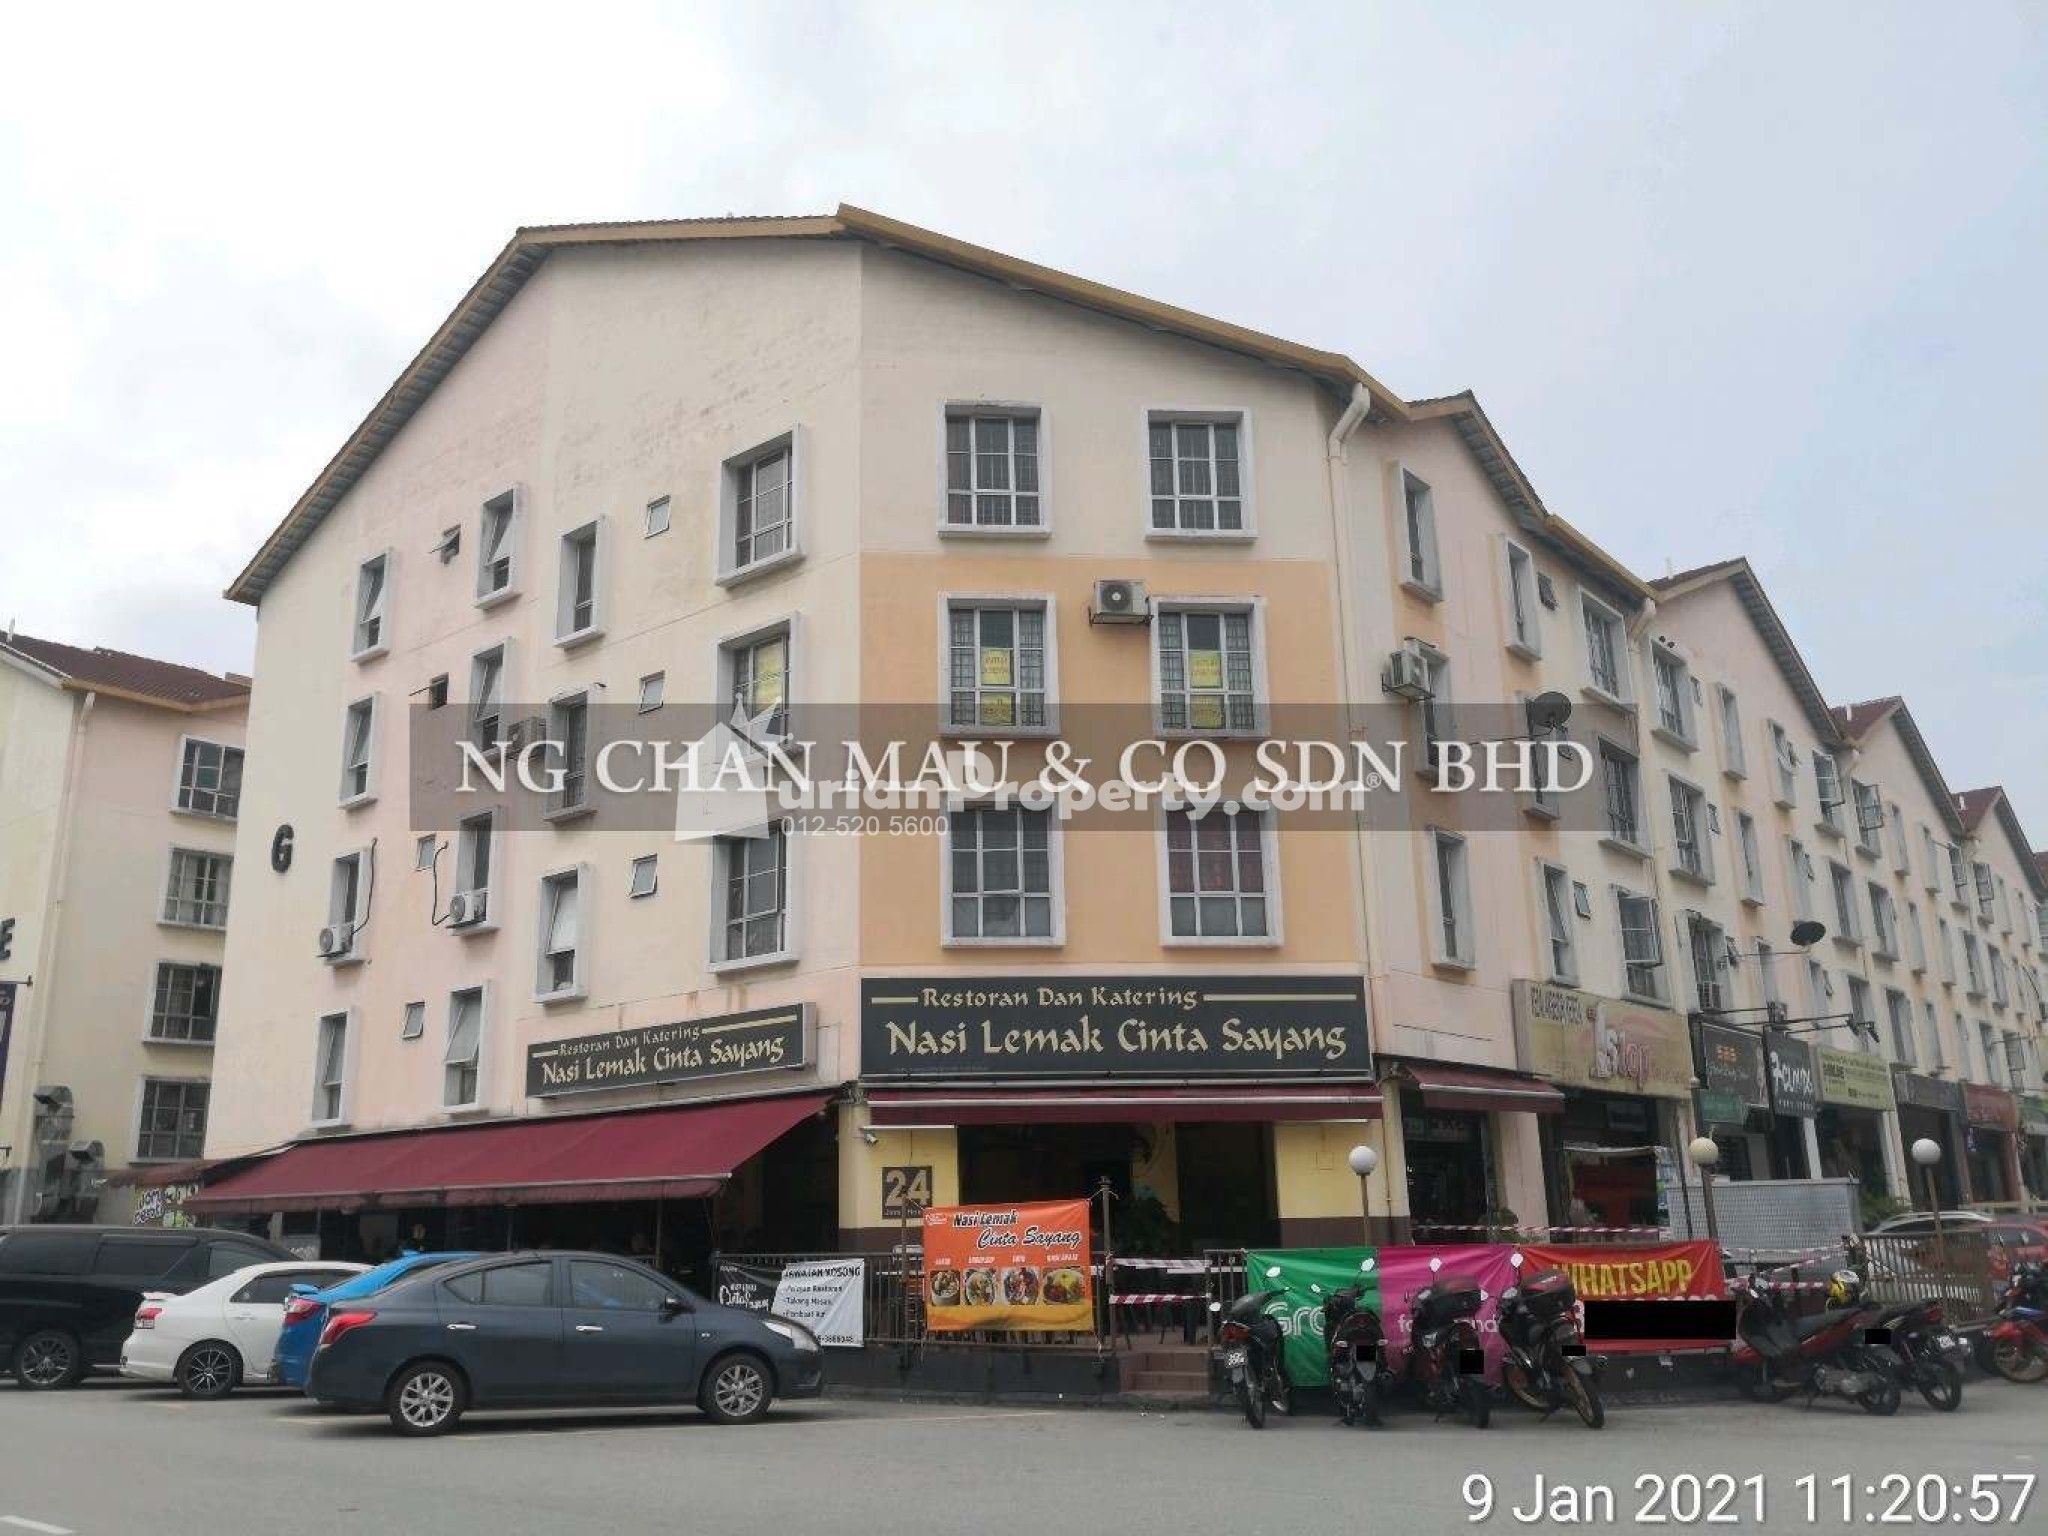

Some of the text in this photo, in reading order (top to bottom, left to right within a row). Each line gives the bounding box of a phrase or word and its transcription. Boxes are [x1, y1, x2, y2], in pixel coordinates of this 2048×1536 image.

[271, 824, 295, 873] G
[921, 985, 1197, 1010] Restoran Dan Katering
[558, 1026, 701, 1057] Restoran Dan Katering
[885, 1014, 1347, 1060] Nasi Lemak Cinta Sayang
[541, 1034, 785, 1085] Nasi Lemak Cinta Sayang
[885, 1168, 931, 1206] 24
[953, 1211, 978, 1227] Nasi
[978, 1225, 1081, 1249] Cinta Sayang
[1265, 1301, 1326, 1336] Gra
